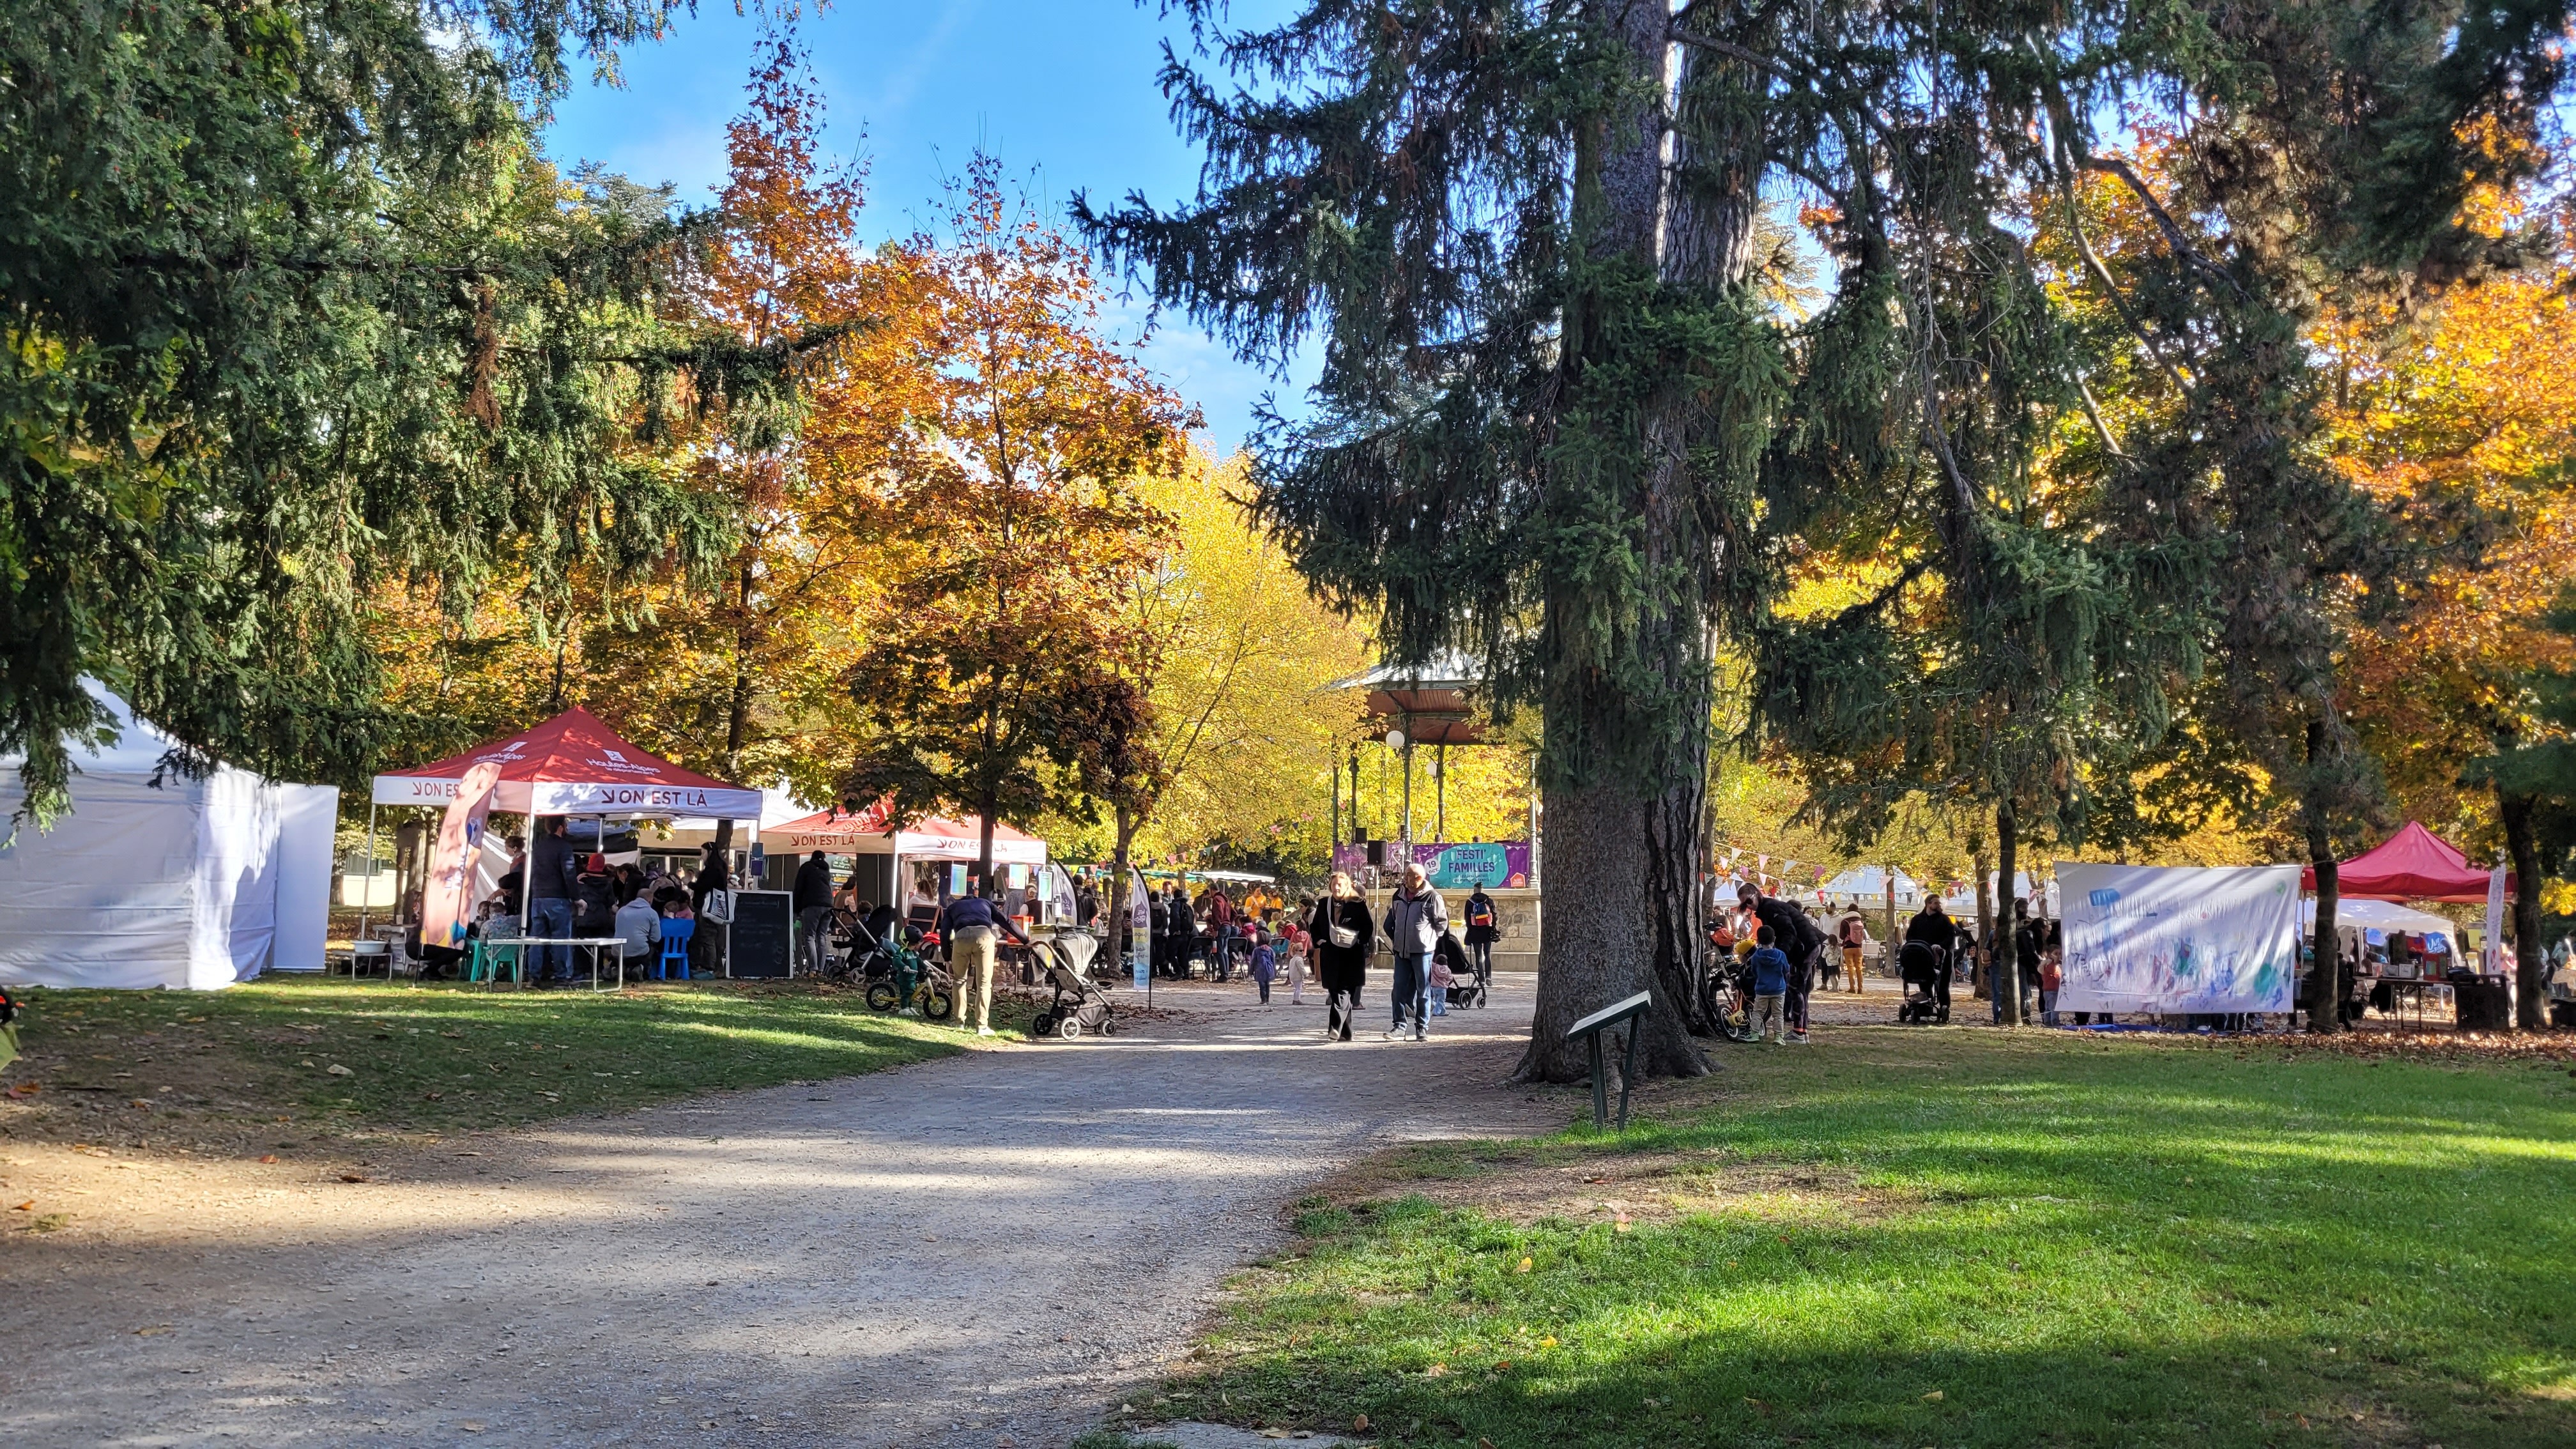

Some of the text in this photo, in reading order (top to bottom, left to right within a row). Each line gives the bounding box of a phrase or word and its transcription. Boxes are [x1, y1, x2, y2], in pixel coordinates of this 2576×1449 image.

[446, 783, 459, 797] ES
[618, 789, 708, 808] ON EST LÀ
[819, 835, 839, 846] EST
[841, 834, 855, 846] LÀ
[1426, 860, 1437, 869] 19
[1448, 861, 1495, 873] FAMILLES
